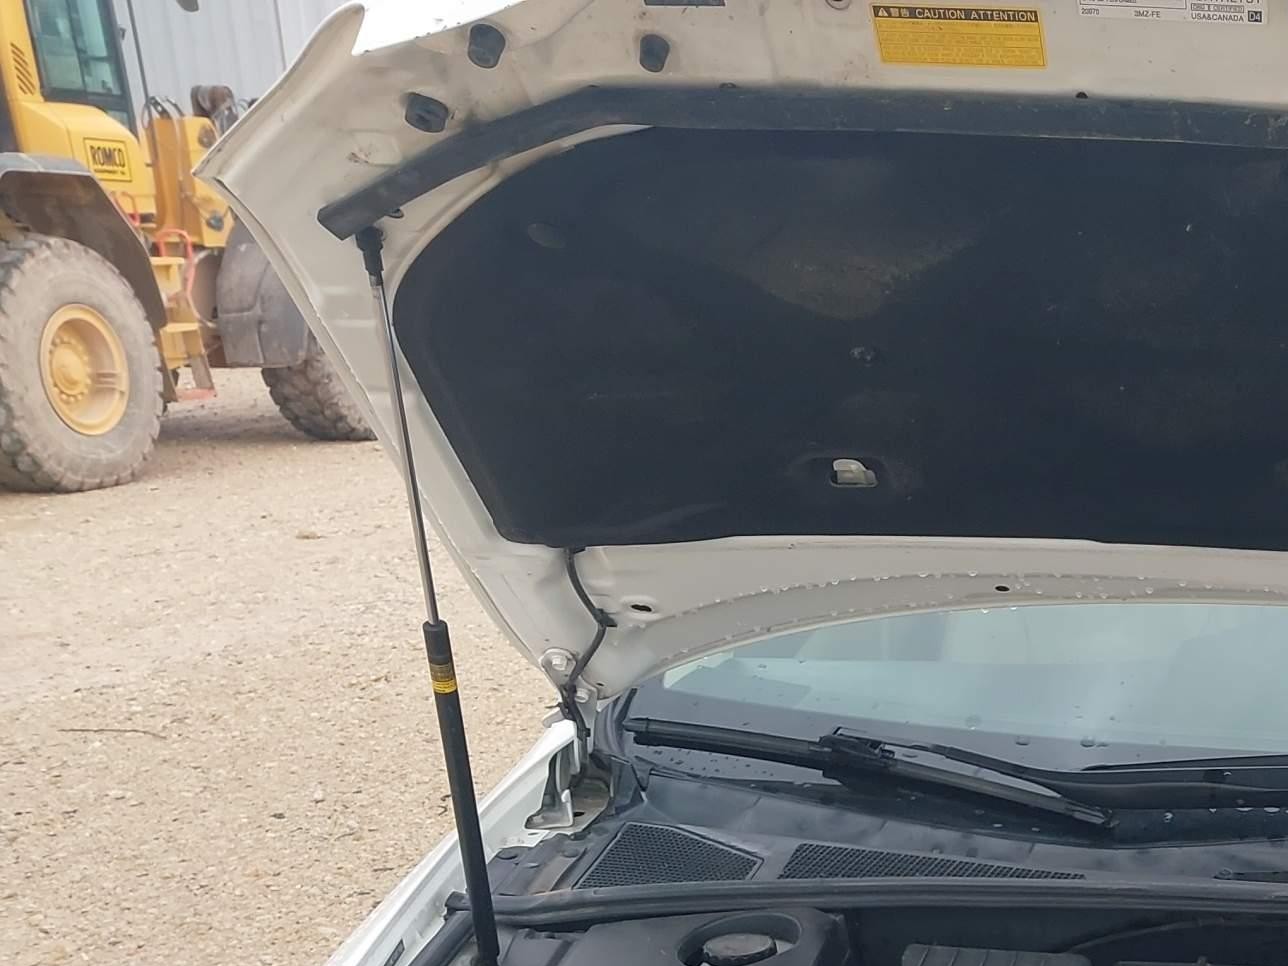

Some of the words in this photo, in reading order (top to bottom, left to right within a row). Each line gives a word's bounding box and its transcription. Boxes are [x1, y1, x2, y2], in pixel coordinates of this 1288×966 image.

[915, 8, 966, 20] CAUTION
[970, 10, 1036, 22] ATTENTION
[1190, 12, 1245, 23] USA&CANADA
[1248, 11, 1262, 22] D4
[90, 144, 126, 169] ROMCO
